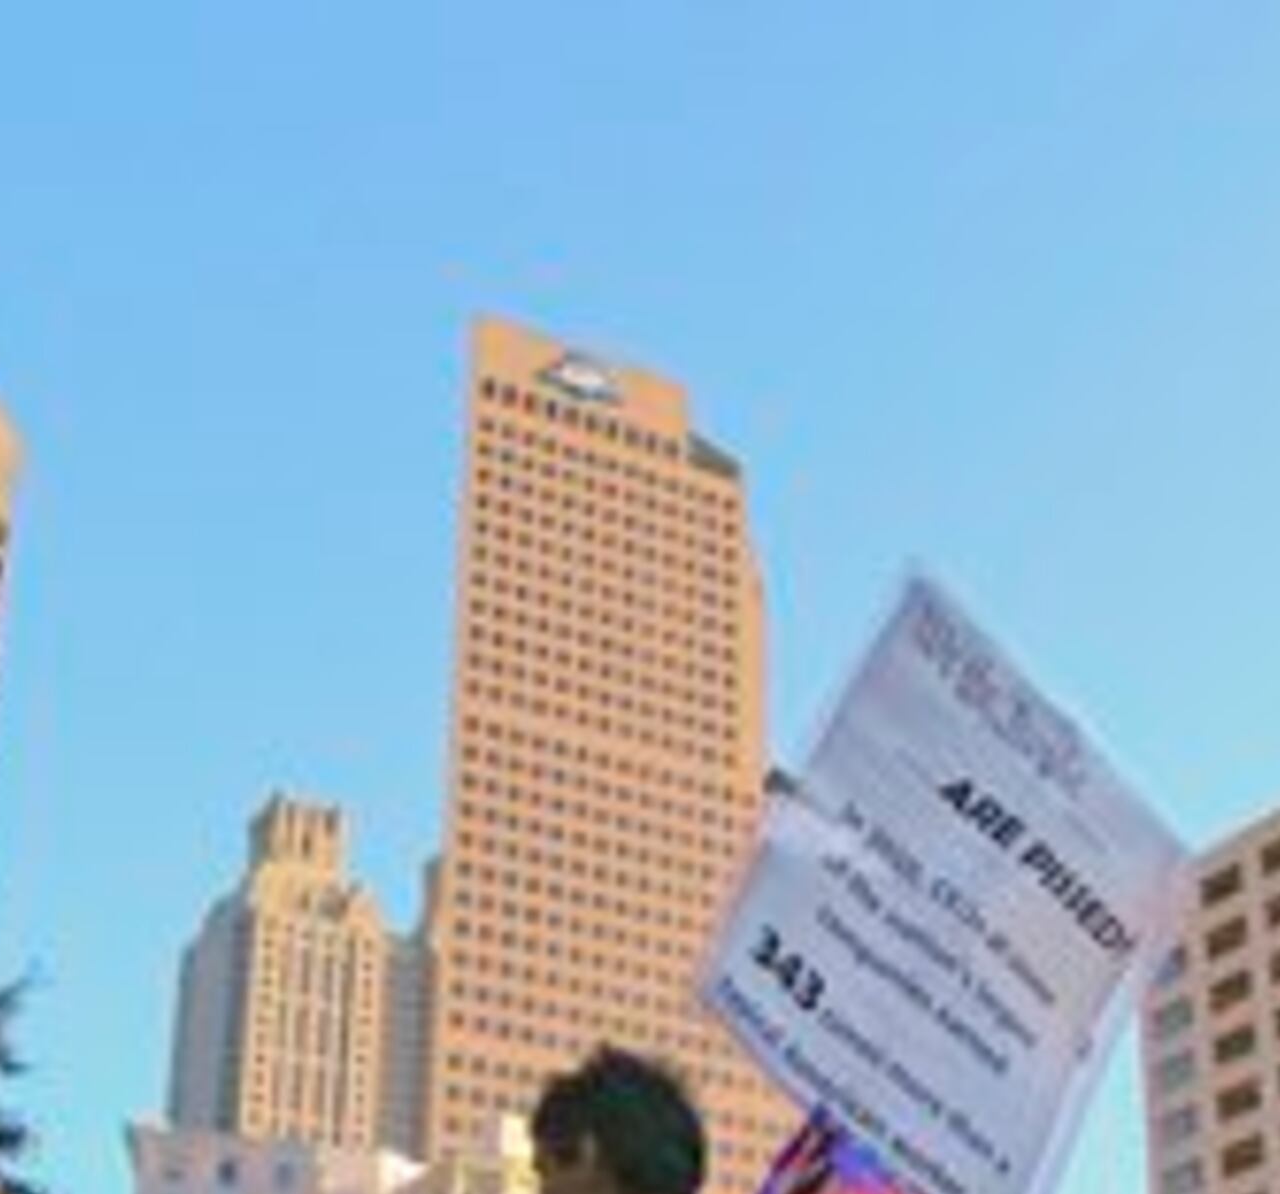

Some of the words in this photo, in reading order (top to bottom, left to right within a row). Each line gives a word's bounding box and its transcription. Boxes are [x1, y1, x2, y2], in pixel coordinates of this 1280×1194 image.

[821, 855, 850, 878] of
[846, 871, 882, 914] the
[937, 774, 1026, 848] ARE
[1017, 838, 1141, 956] PISSED!
[753, 925, 825, 1011] 343
[885, 1061, 944, 1118] more
[946, 1110, 994, 1160] than
